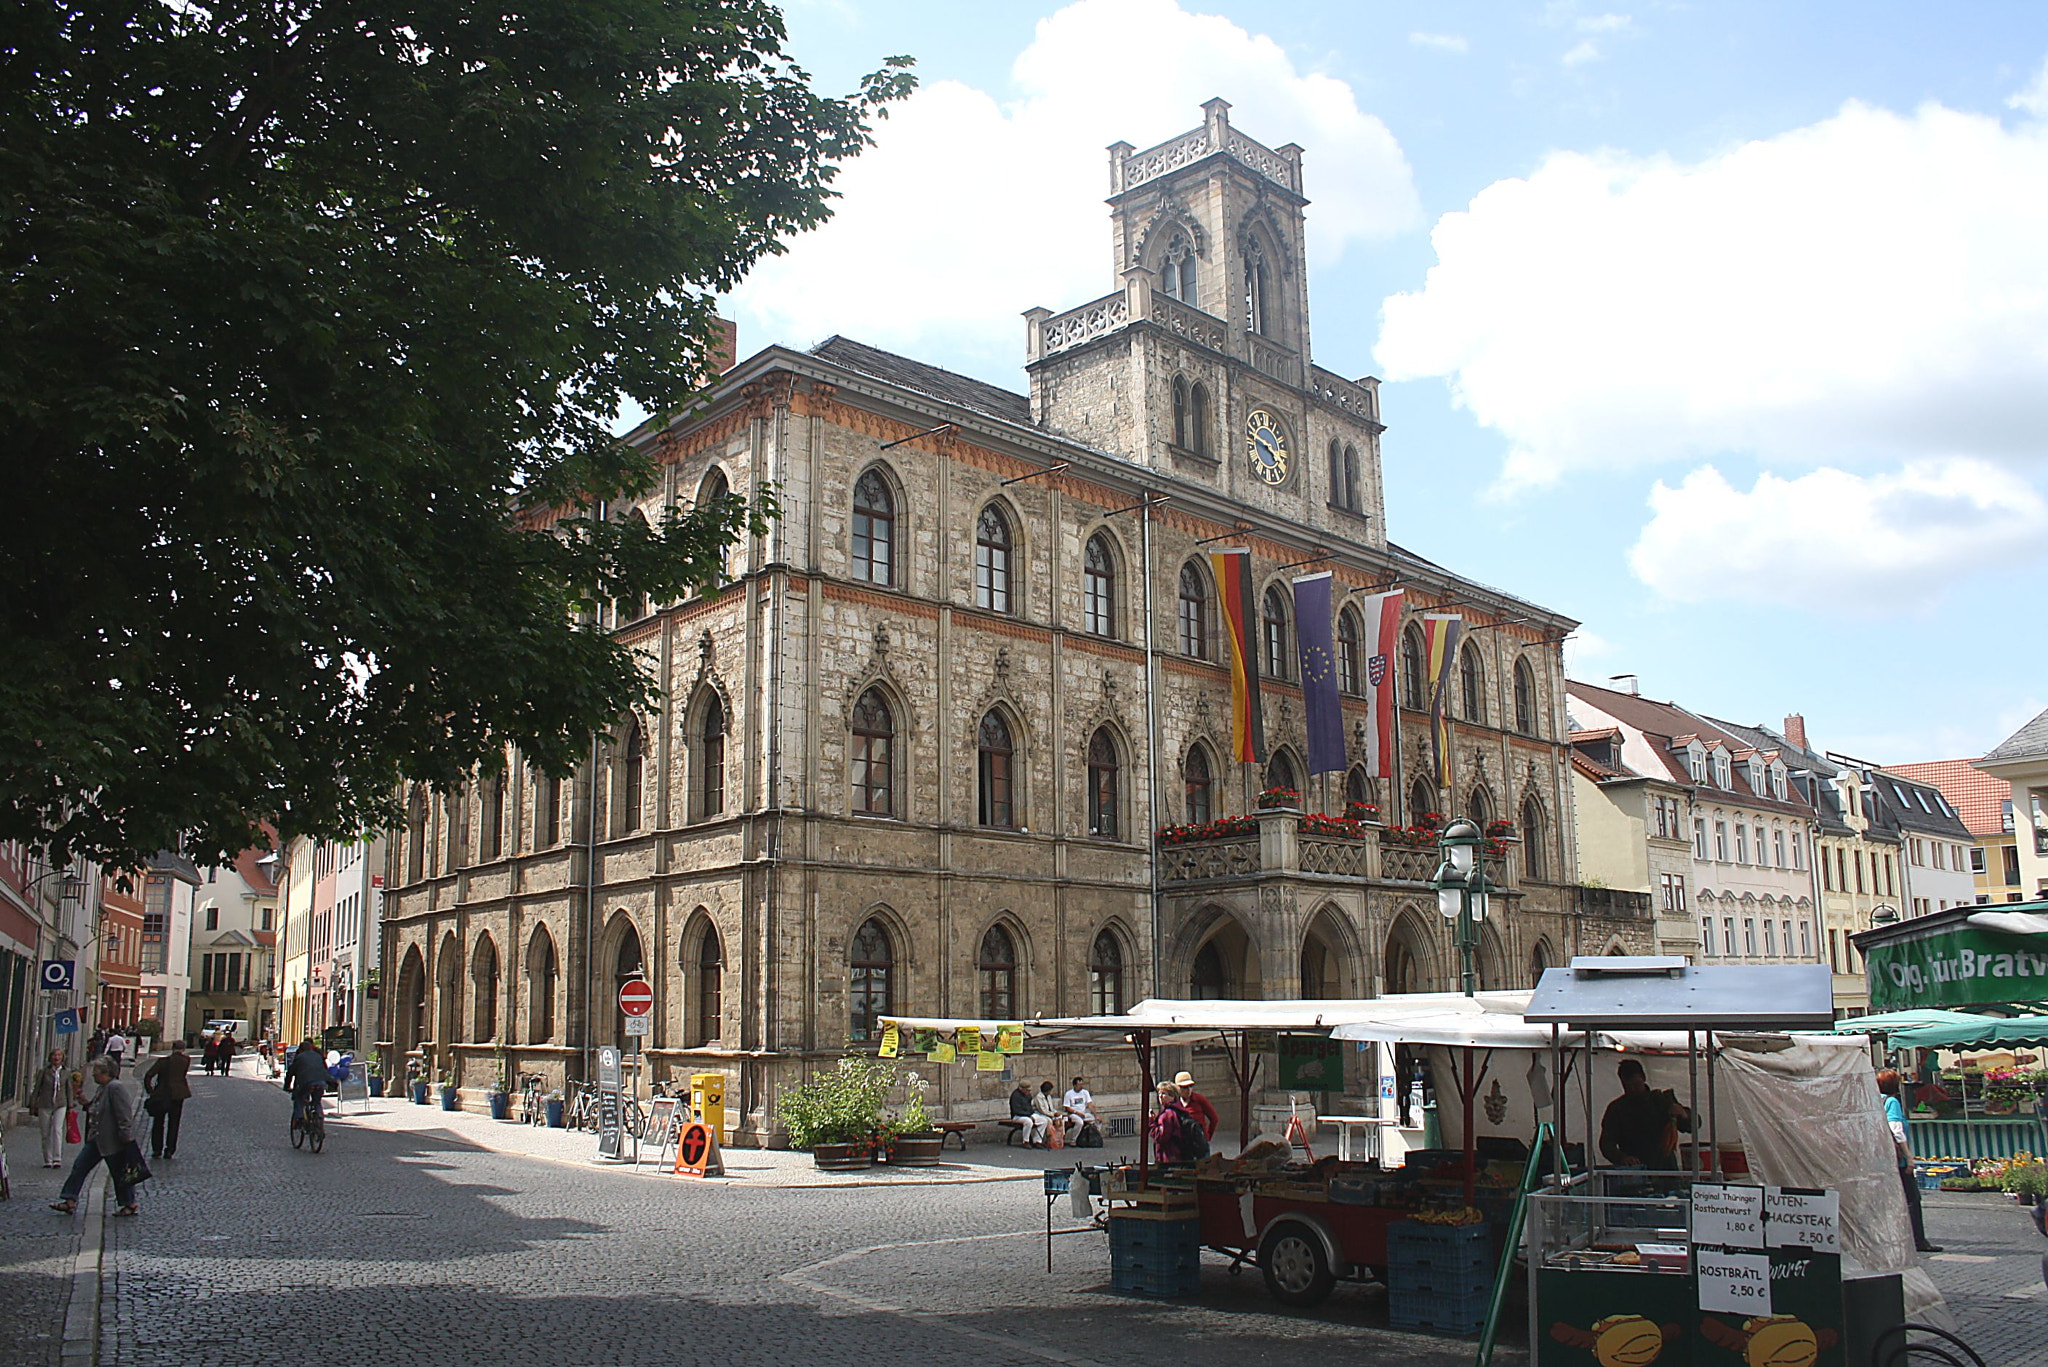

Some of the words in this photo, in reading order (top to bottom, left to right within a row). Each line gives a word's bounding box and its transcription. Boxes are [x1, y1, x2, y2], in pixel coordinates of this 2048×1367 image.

[1694, 1191, 1720, 1202] Original
[1722, 1192, 1757, 1204] Thüringer
[1767, 1194, 1808, 1208] PUTEN-
[1693, 1203, 1752, 1216] Rostbratwurst
[1768, 1211, 1832, 1229] HACKSTEAK
[1748, 1223, 1756, 1232] €
[1826, 1234, 1835, 1245] €
[1700, 1264, 1763, 1281] ROSTBRÄTL
[1757, 1287, 1766, 1298] €
